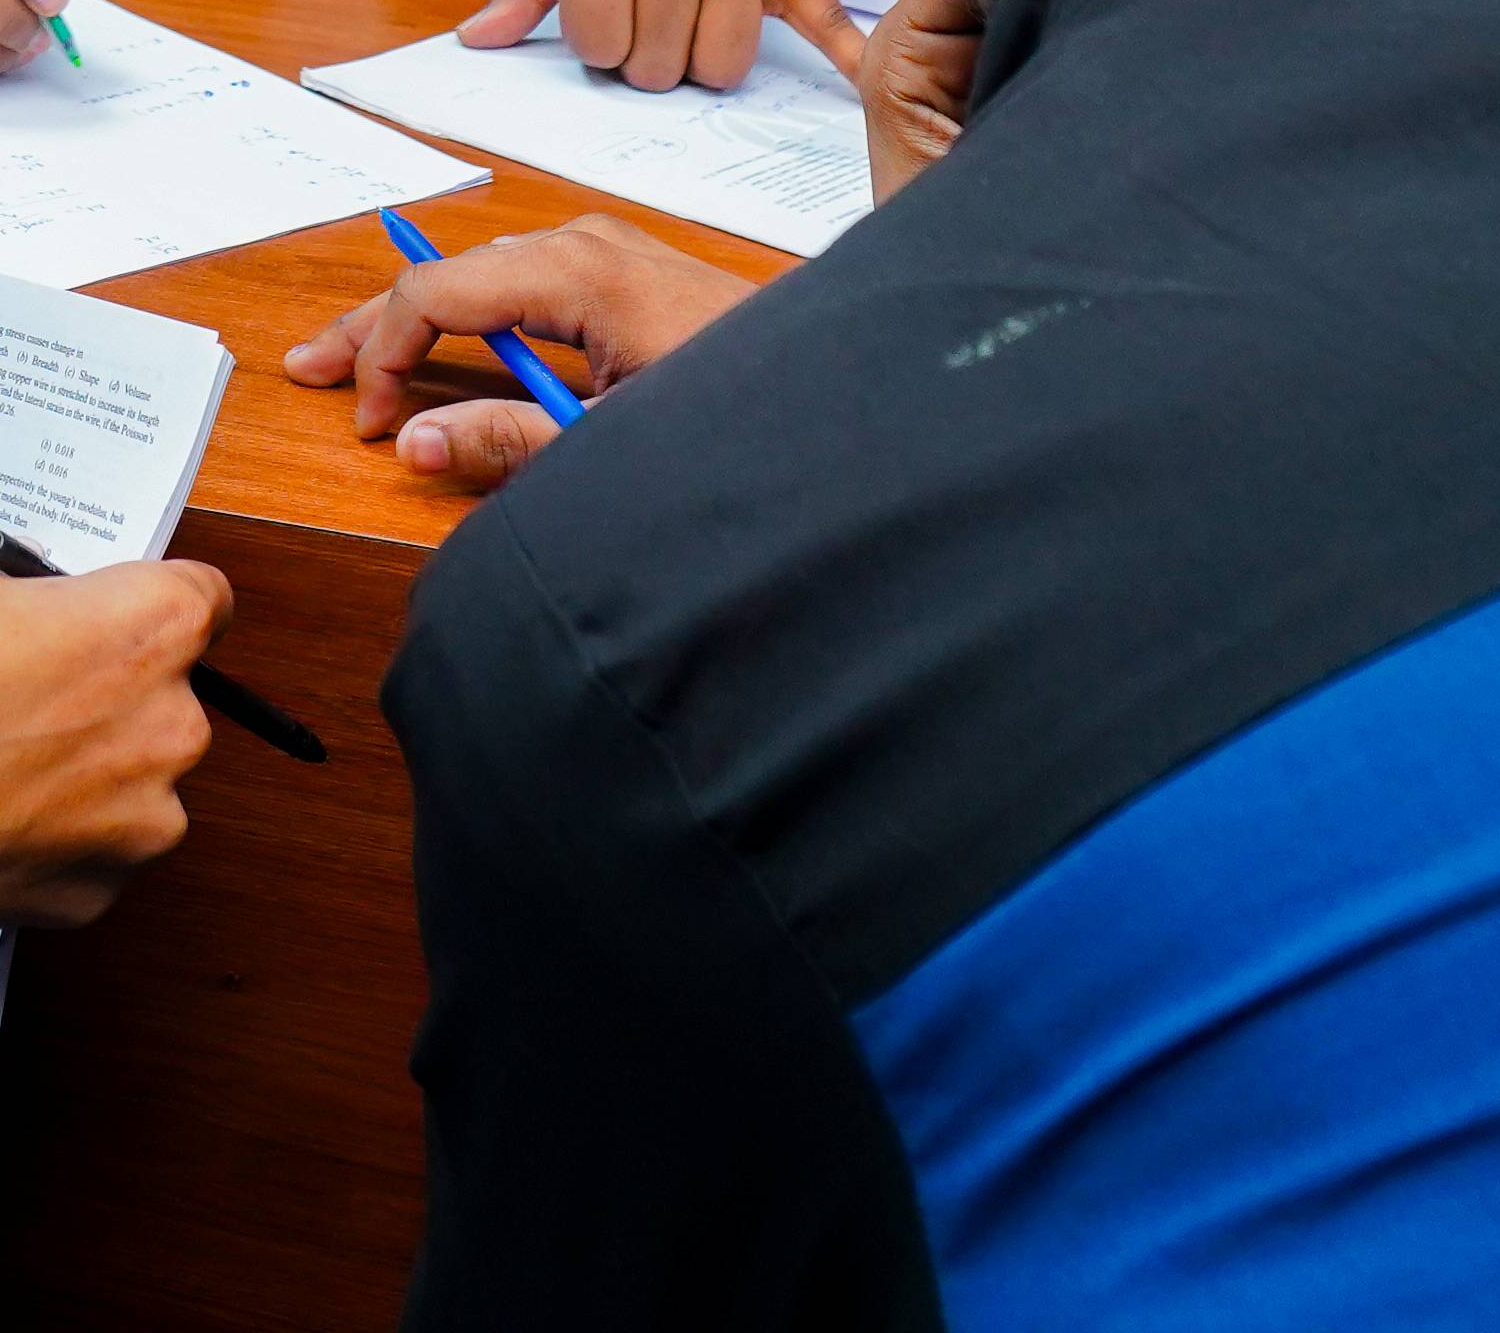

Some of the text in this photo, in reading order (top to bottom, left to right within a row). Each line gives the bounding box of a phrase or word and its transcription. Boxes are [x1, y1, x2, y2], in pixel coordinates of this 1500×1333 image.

[4, 328, 25, 341] stress
[50, 340, 75, 357] change
[31, 354, 59, 372] Breadth
[64, 365, 75, 379] (c)
[78, 369, 99, 386] Shape
[108, 379, 120, 393] (d)
